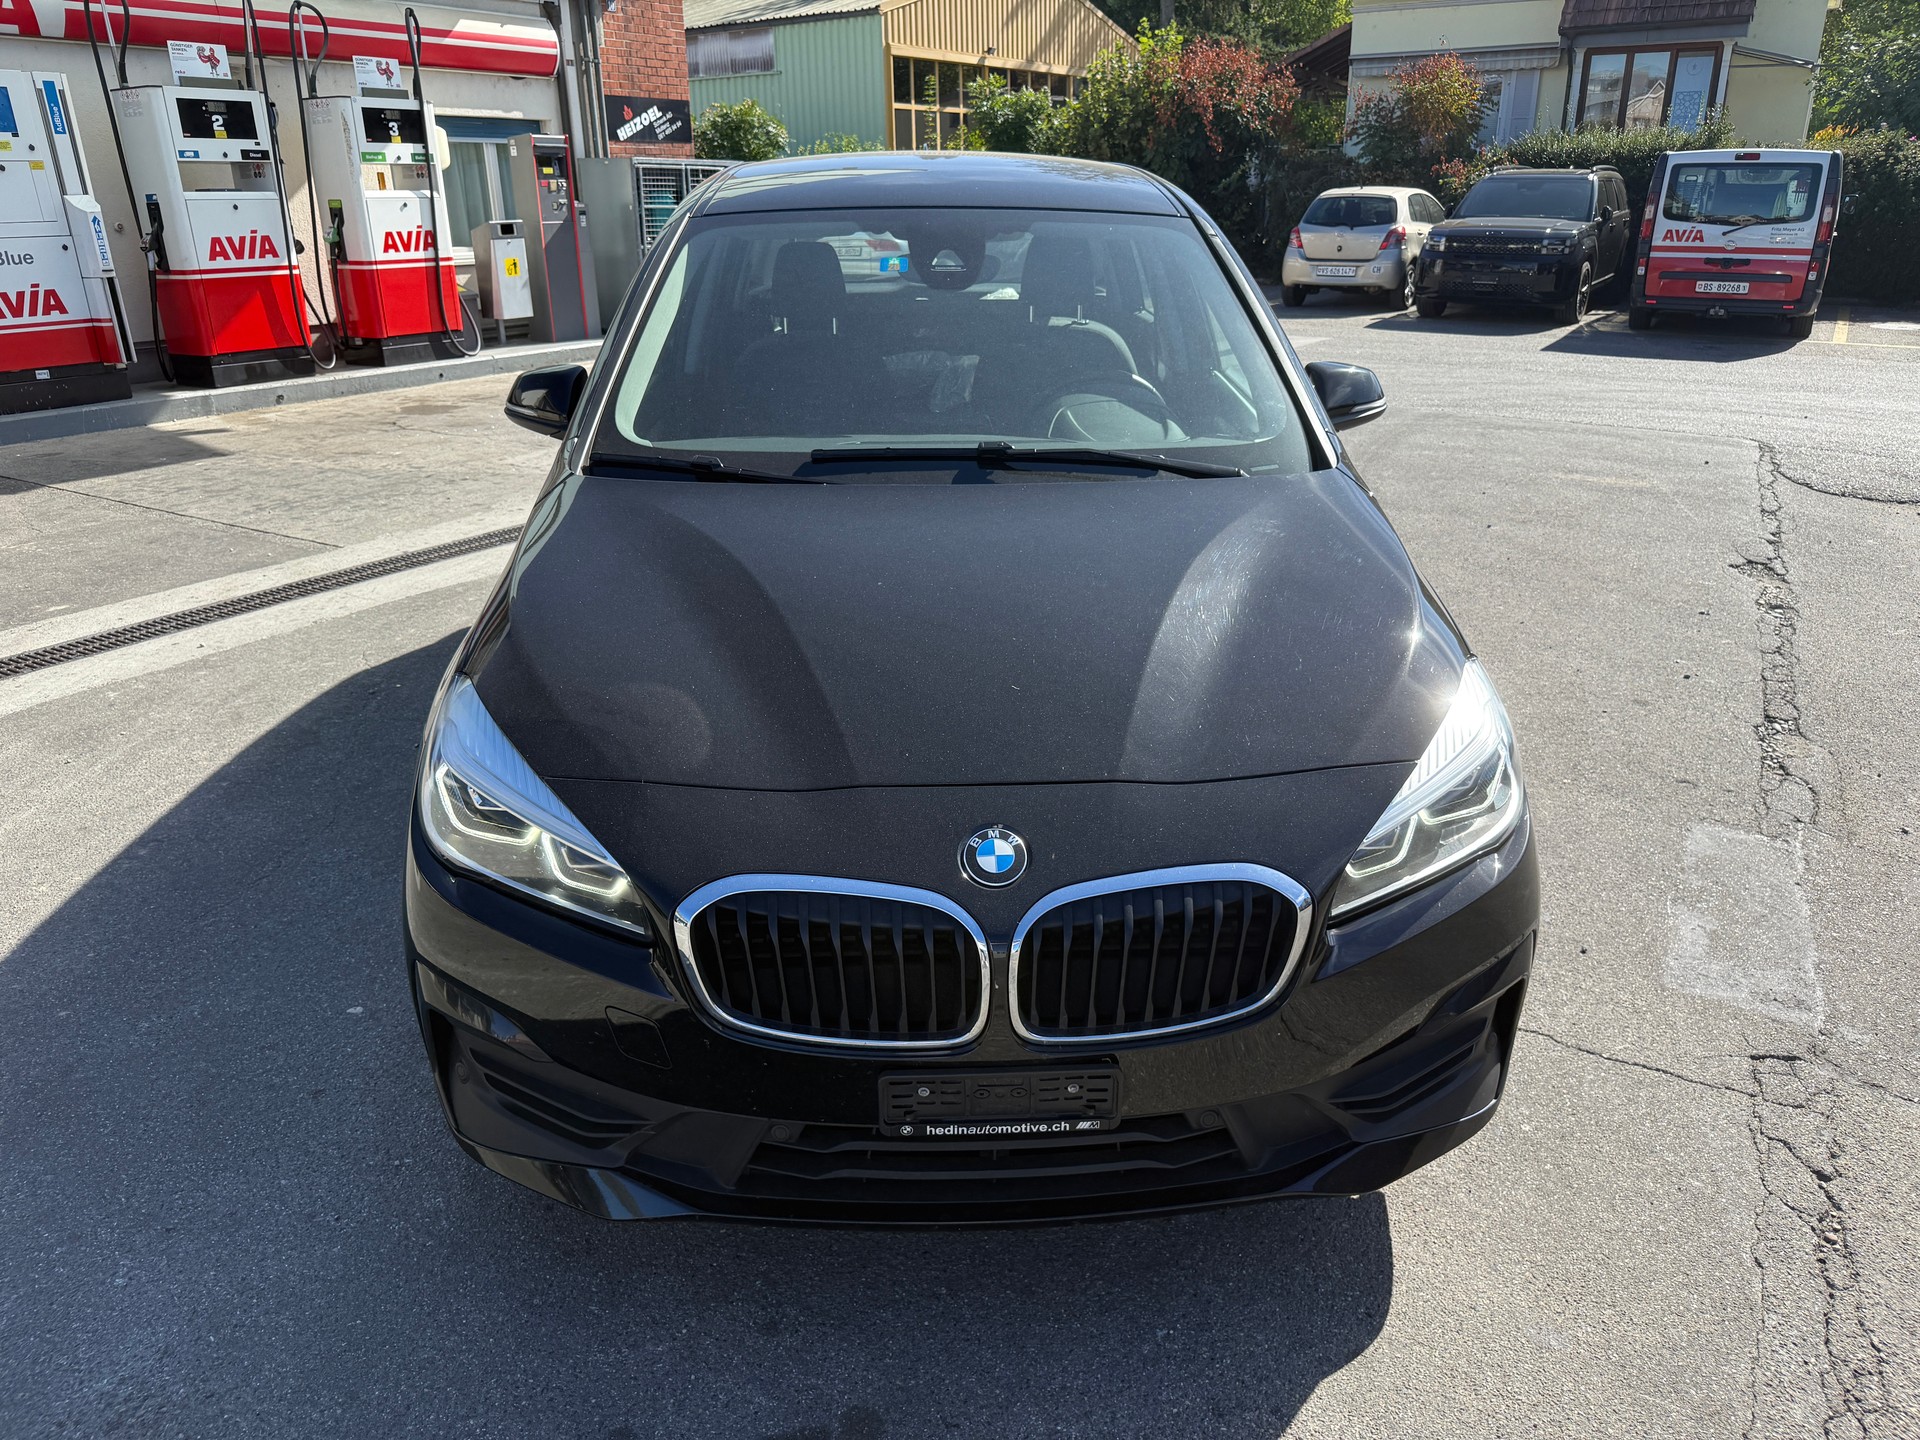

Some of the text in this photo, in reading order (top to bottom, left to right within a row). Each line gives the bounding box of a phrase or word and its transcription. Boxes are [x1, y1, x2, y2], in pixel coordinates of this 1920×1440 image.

[211, 114, 225, 131] 2
[388, 121, 399, 136] 3
[616, 105, 663, 141] HEIZOEL
[383, 225, 435, 253] AVIA
[1662, 226, 1705, 243] AVIA
[208, 229, 280, 261] AVIA
[1372, 265, 1381, 274] CH
[969, 830, 1021, 849] BMW
[926, 1121, 1070, 1136] hedinautomotive.ch
